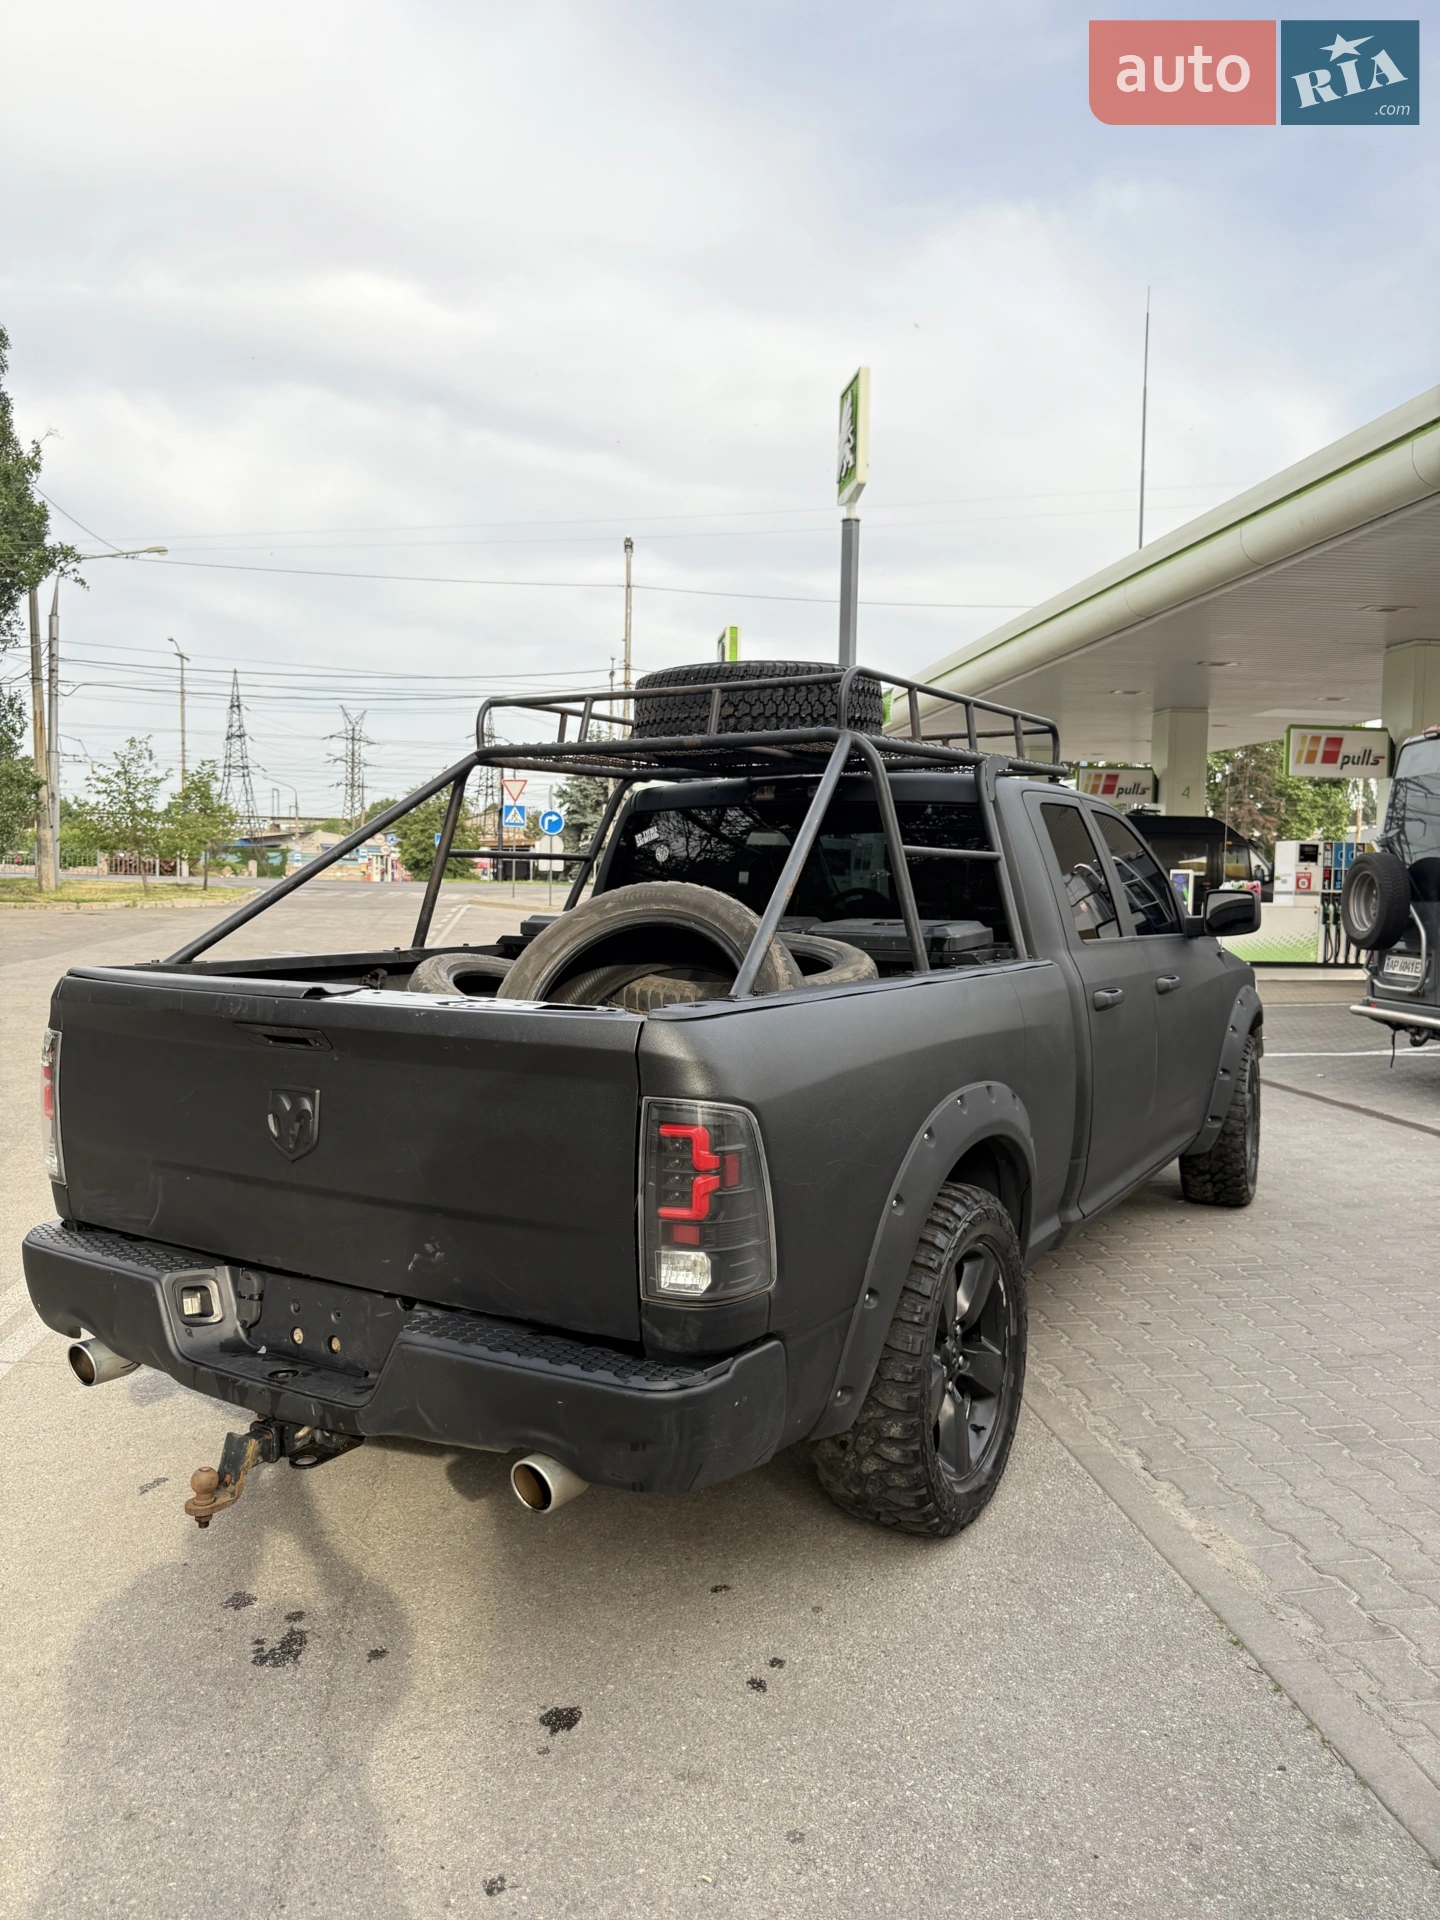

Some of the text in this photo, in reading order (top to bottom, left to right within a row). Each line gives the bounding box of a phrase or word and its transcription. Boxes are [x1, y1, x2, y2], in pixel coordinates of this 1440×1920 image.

[1339, 748, 1386, 771] pulls
[1115, 782, 1151, 799] pulls
[1181, 785, 1190, 799] 4
